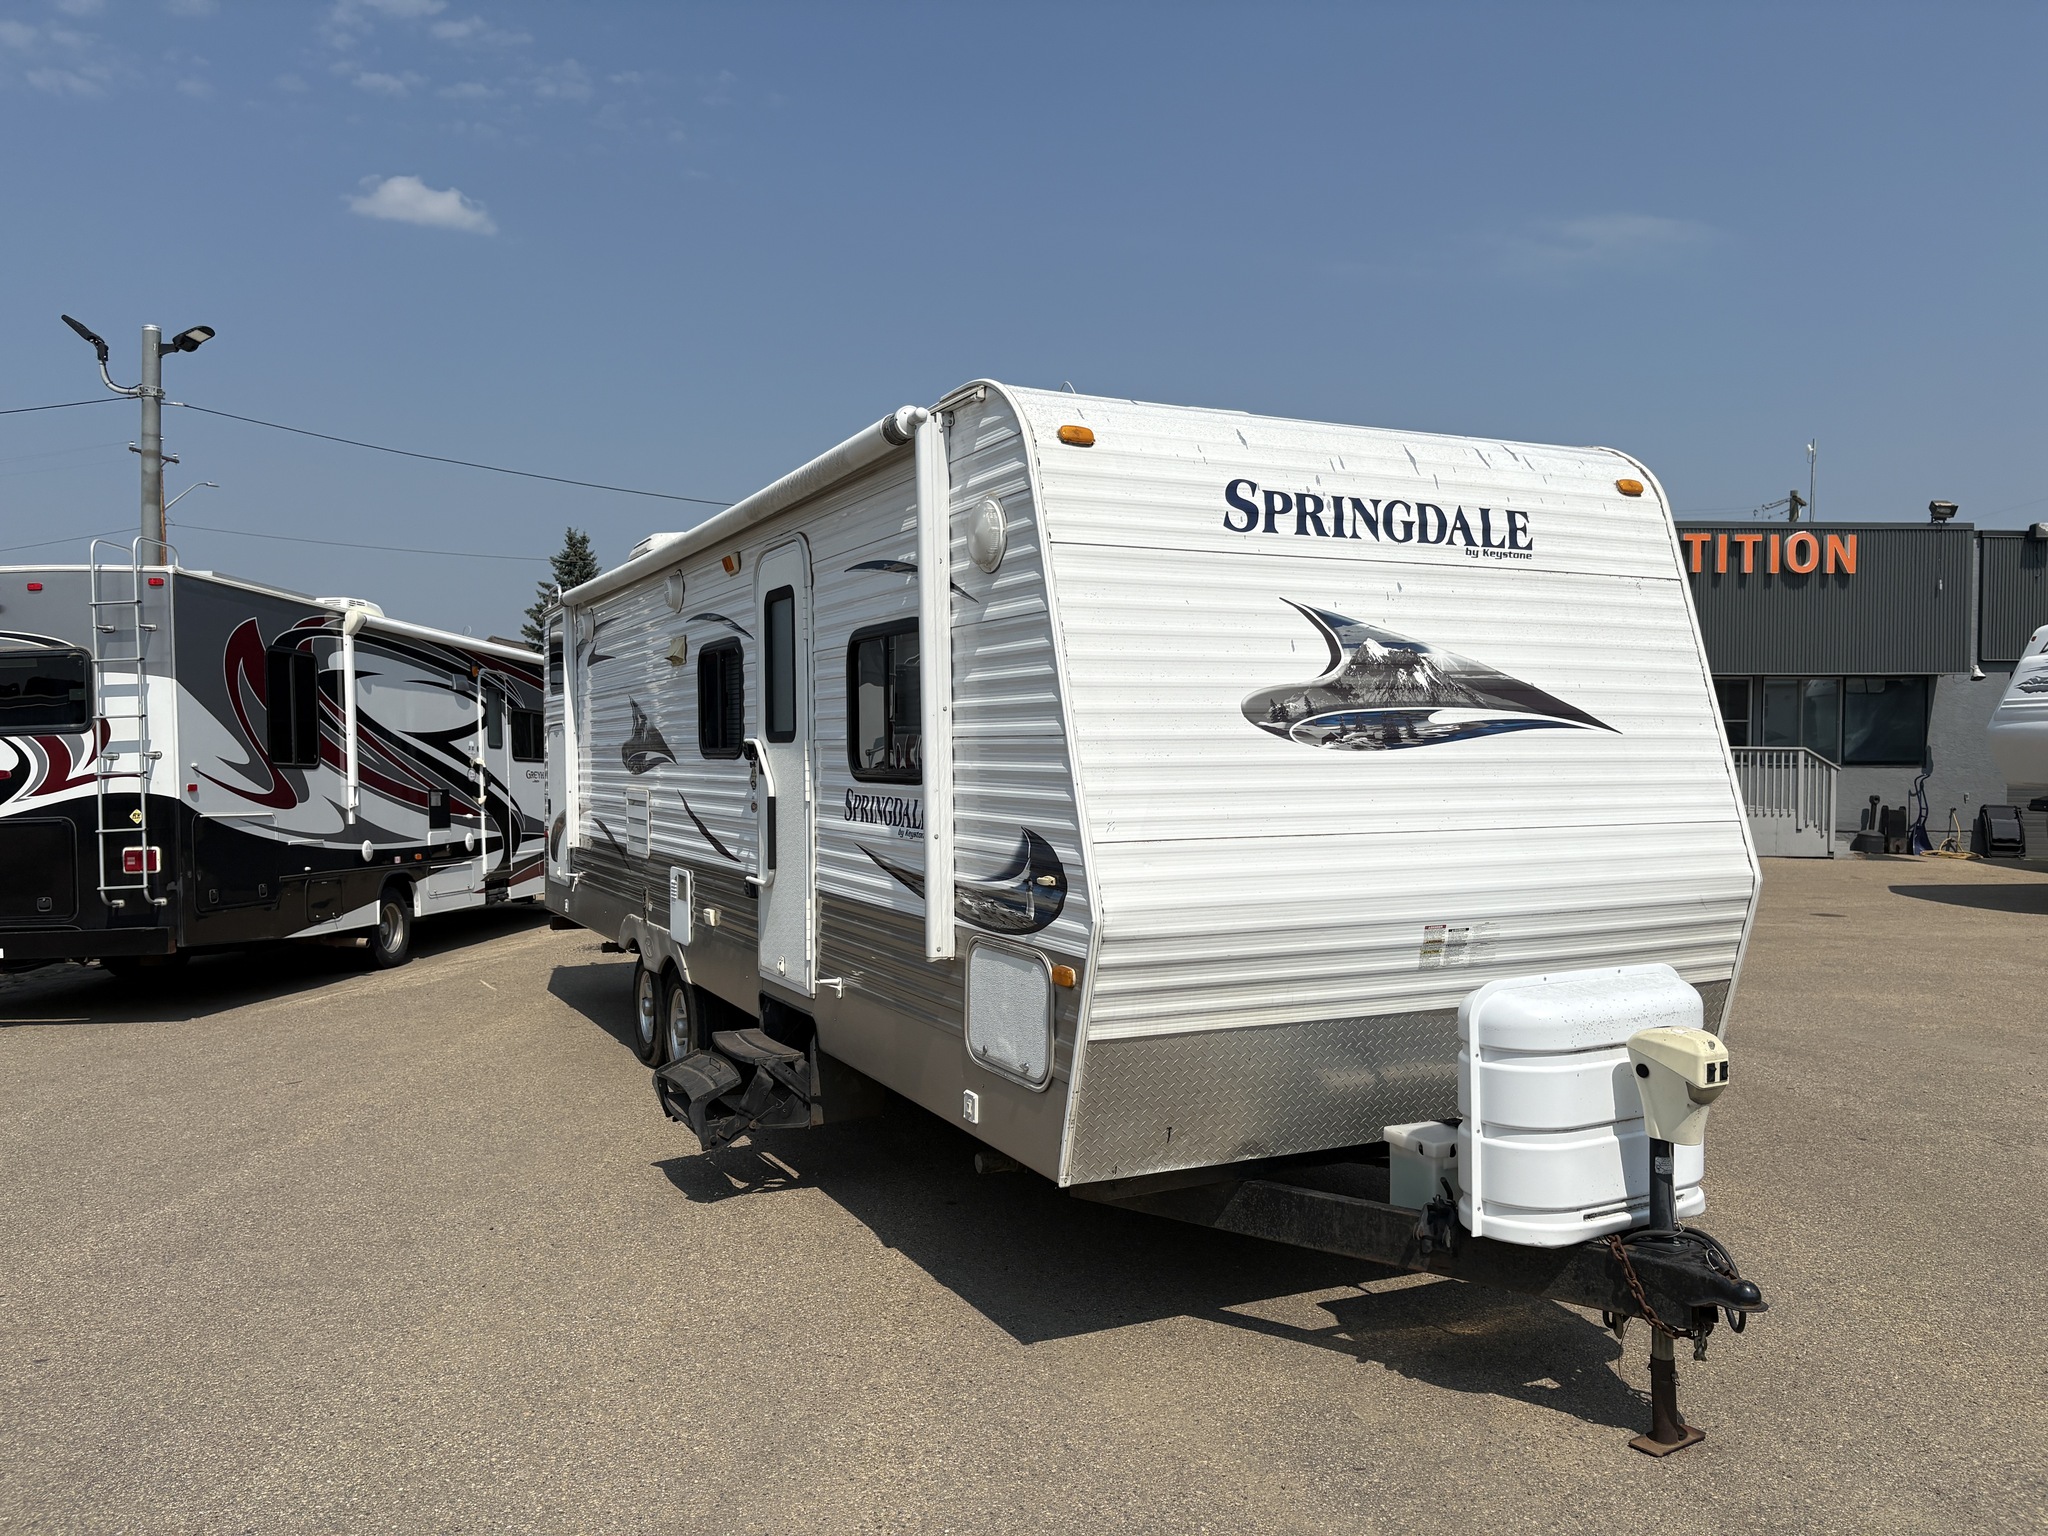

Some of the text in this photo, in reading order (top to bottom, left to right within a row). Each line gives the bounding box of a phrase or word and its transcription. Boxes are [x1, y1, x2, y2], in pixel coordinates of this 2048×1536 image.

[1223, 479, 1533, 550] SPRINGDALE
[1465, 547, 1533, 560] by Keystone
[1683, 531, 1857, 574] TITION
